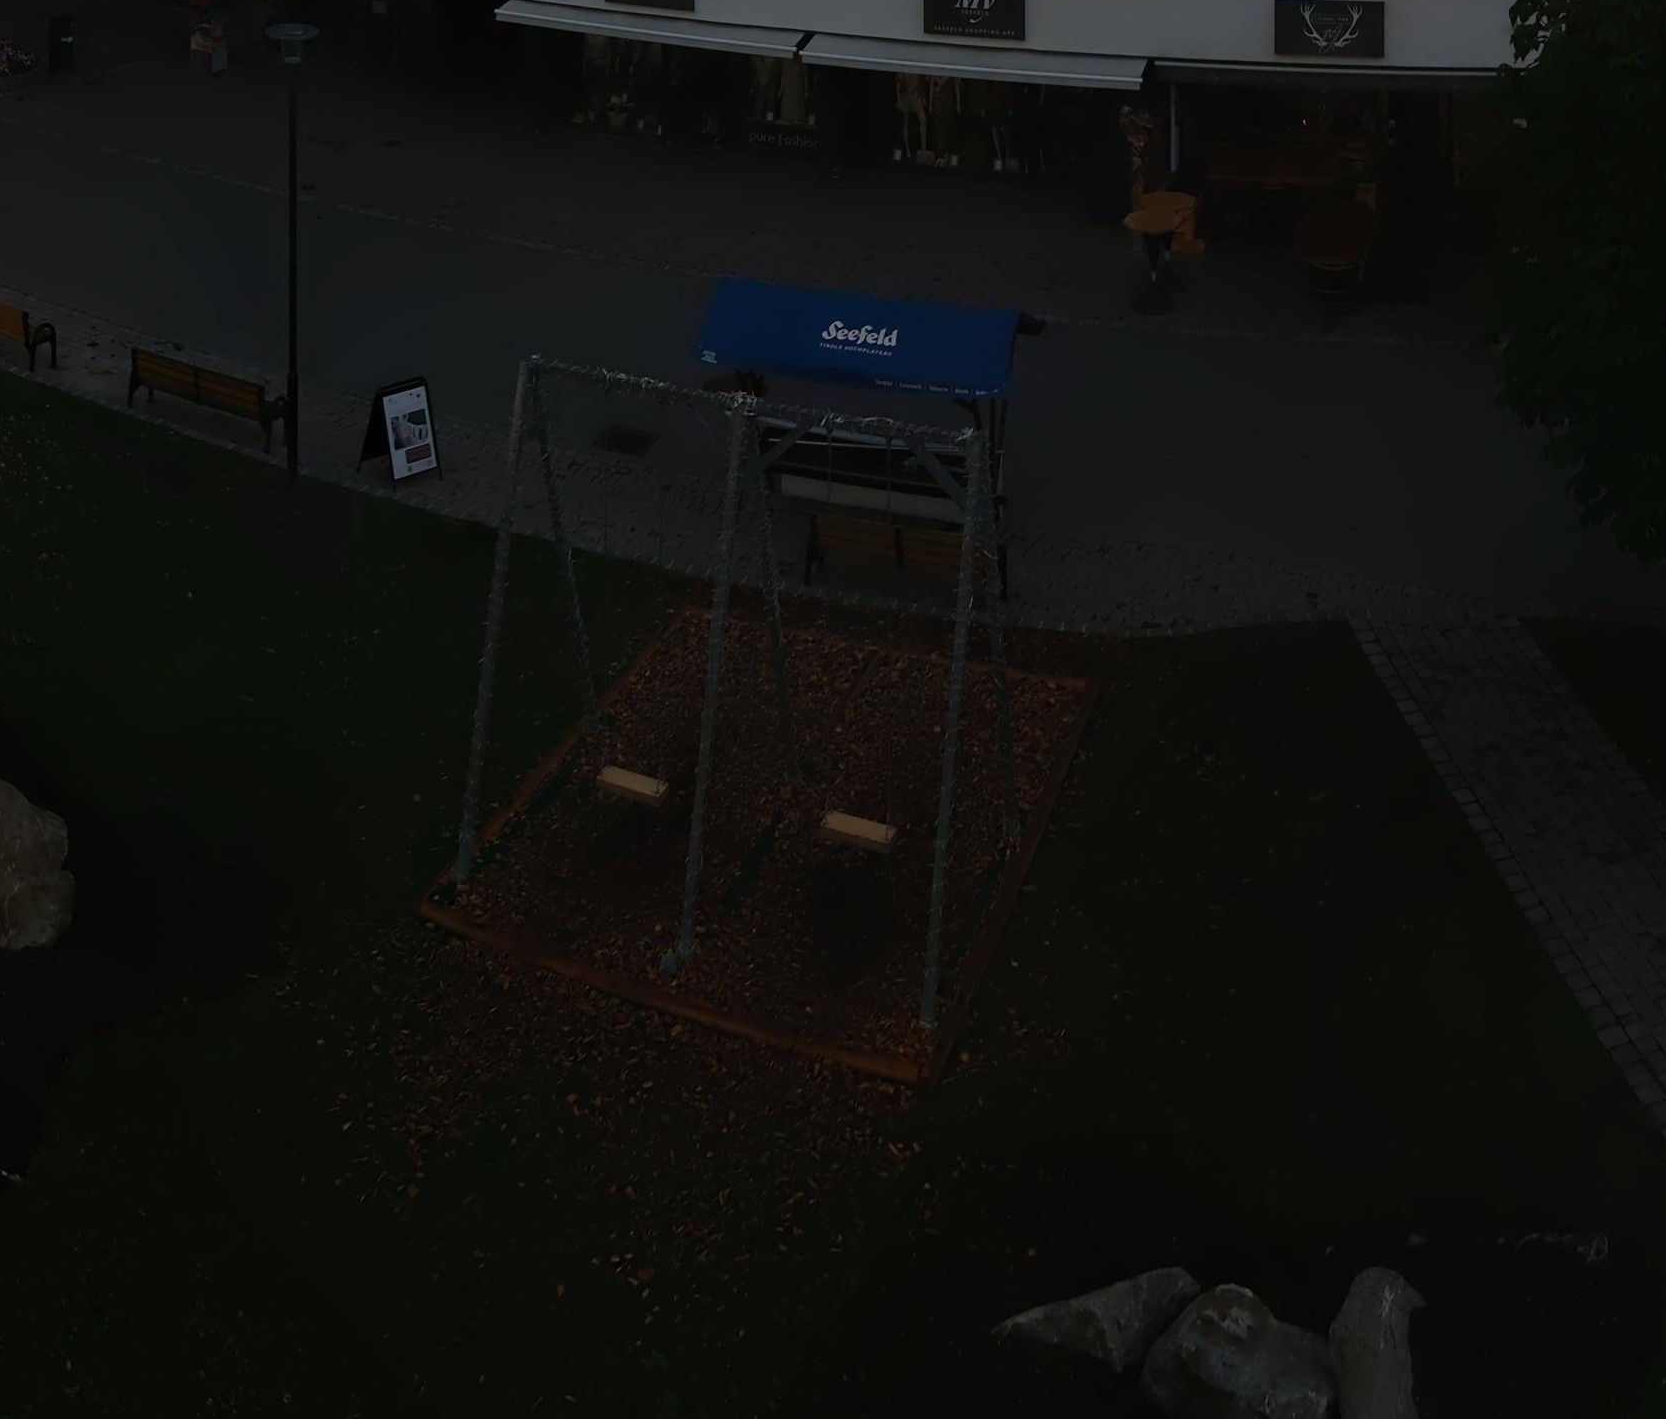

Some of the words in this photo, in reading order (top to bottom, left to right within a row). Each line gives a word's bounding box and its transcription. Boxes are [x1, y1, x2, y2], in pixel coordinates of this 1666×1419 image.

[934, 25, 963, 33] SEEFELD
[965, 28, 1000, 36] SHOPPING
[749, 132, 775, 143] pure
[822, 321, 899, 348] Seefeld
